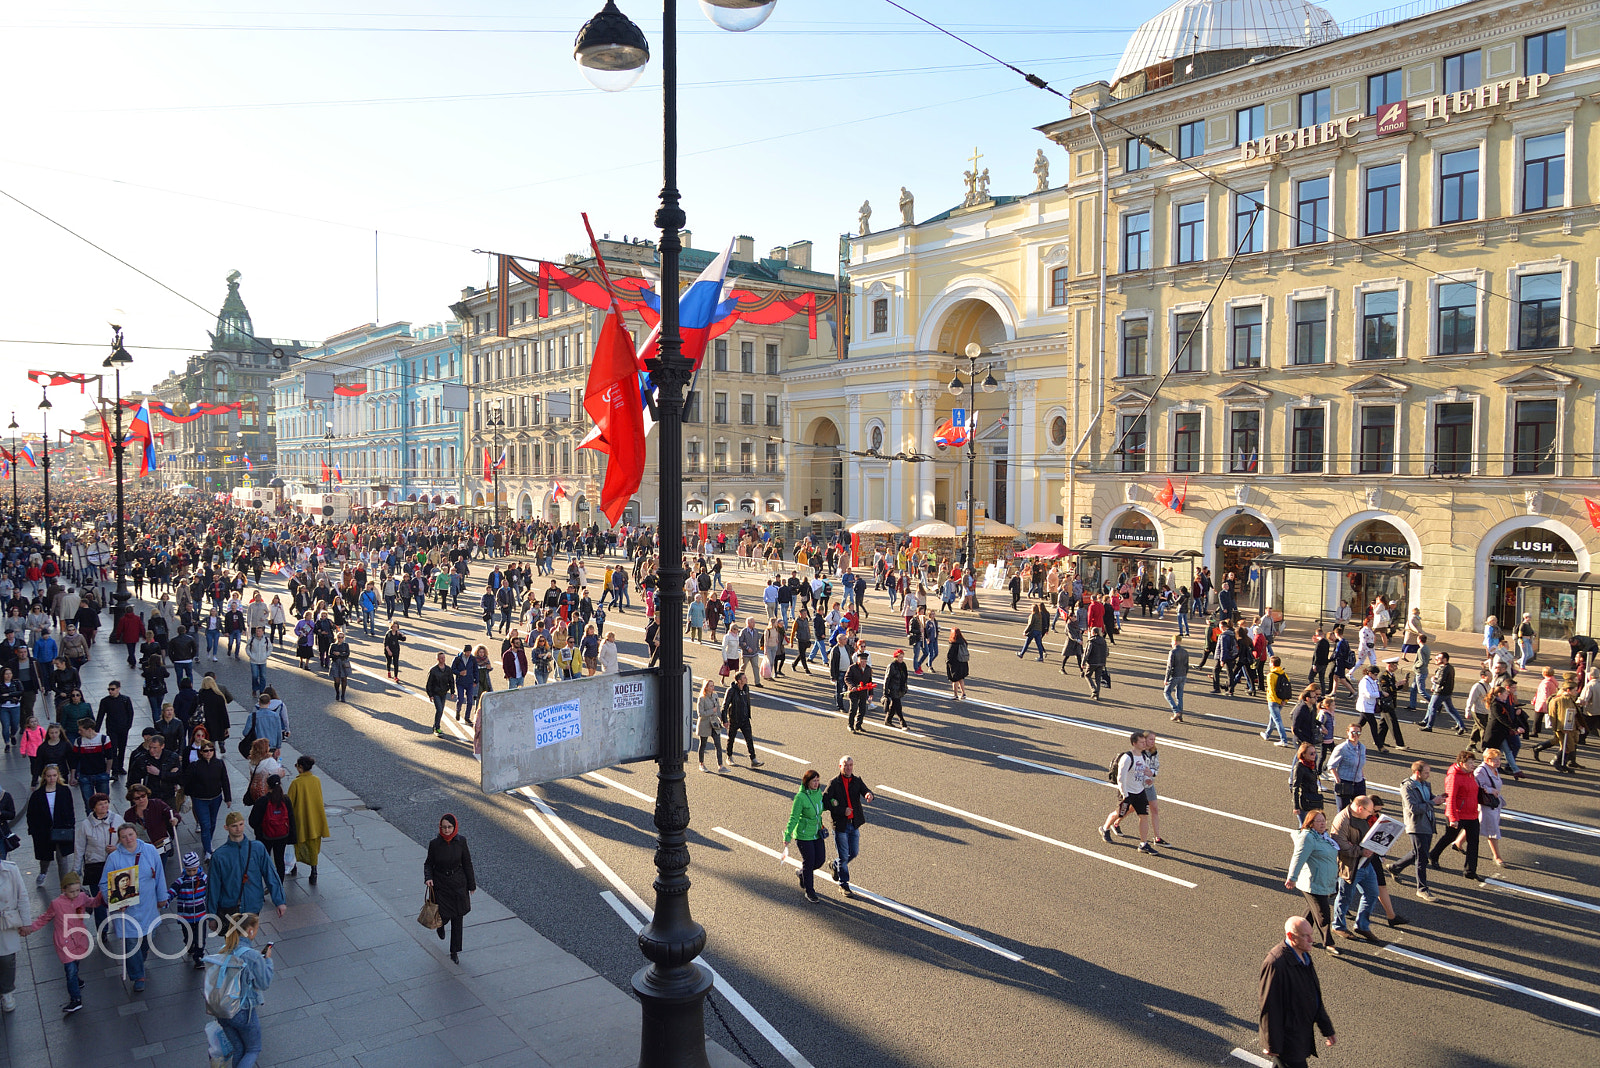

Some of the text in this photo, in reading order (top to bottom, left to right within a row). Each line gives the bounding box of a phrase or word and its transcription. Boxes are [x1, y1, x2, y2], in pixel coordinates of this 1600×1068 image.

[1240, 73, 1551, 162] БИЗНЕС ЦЕНТР
[1379, 121, 1405, 132] АЛПОЛ
[1114, 534, 1156, 542] intimissimi
[1222, 538, 1270, 549] CALZEDONIA
[1347, 543, 1408, 557] FALCONERI
[1513, 541, 1553, 552] LUSH
[614, 683, 643, 695] ХОСТЕЛ
[534, 703, 579, 722] ГОСТИНИЧНЫЕ
[543, 712, 572, 724] ЧЕКИ
[536, 723, 580, 745] 903-65-73
